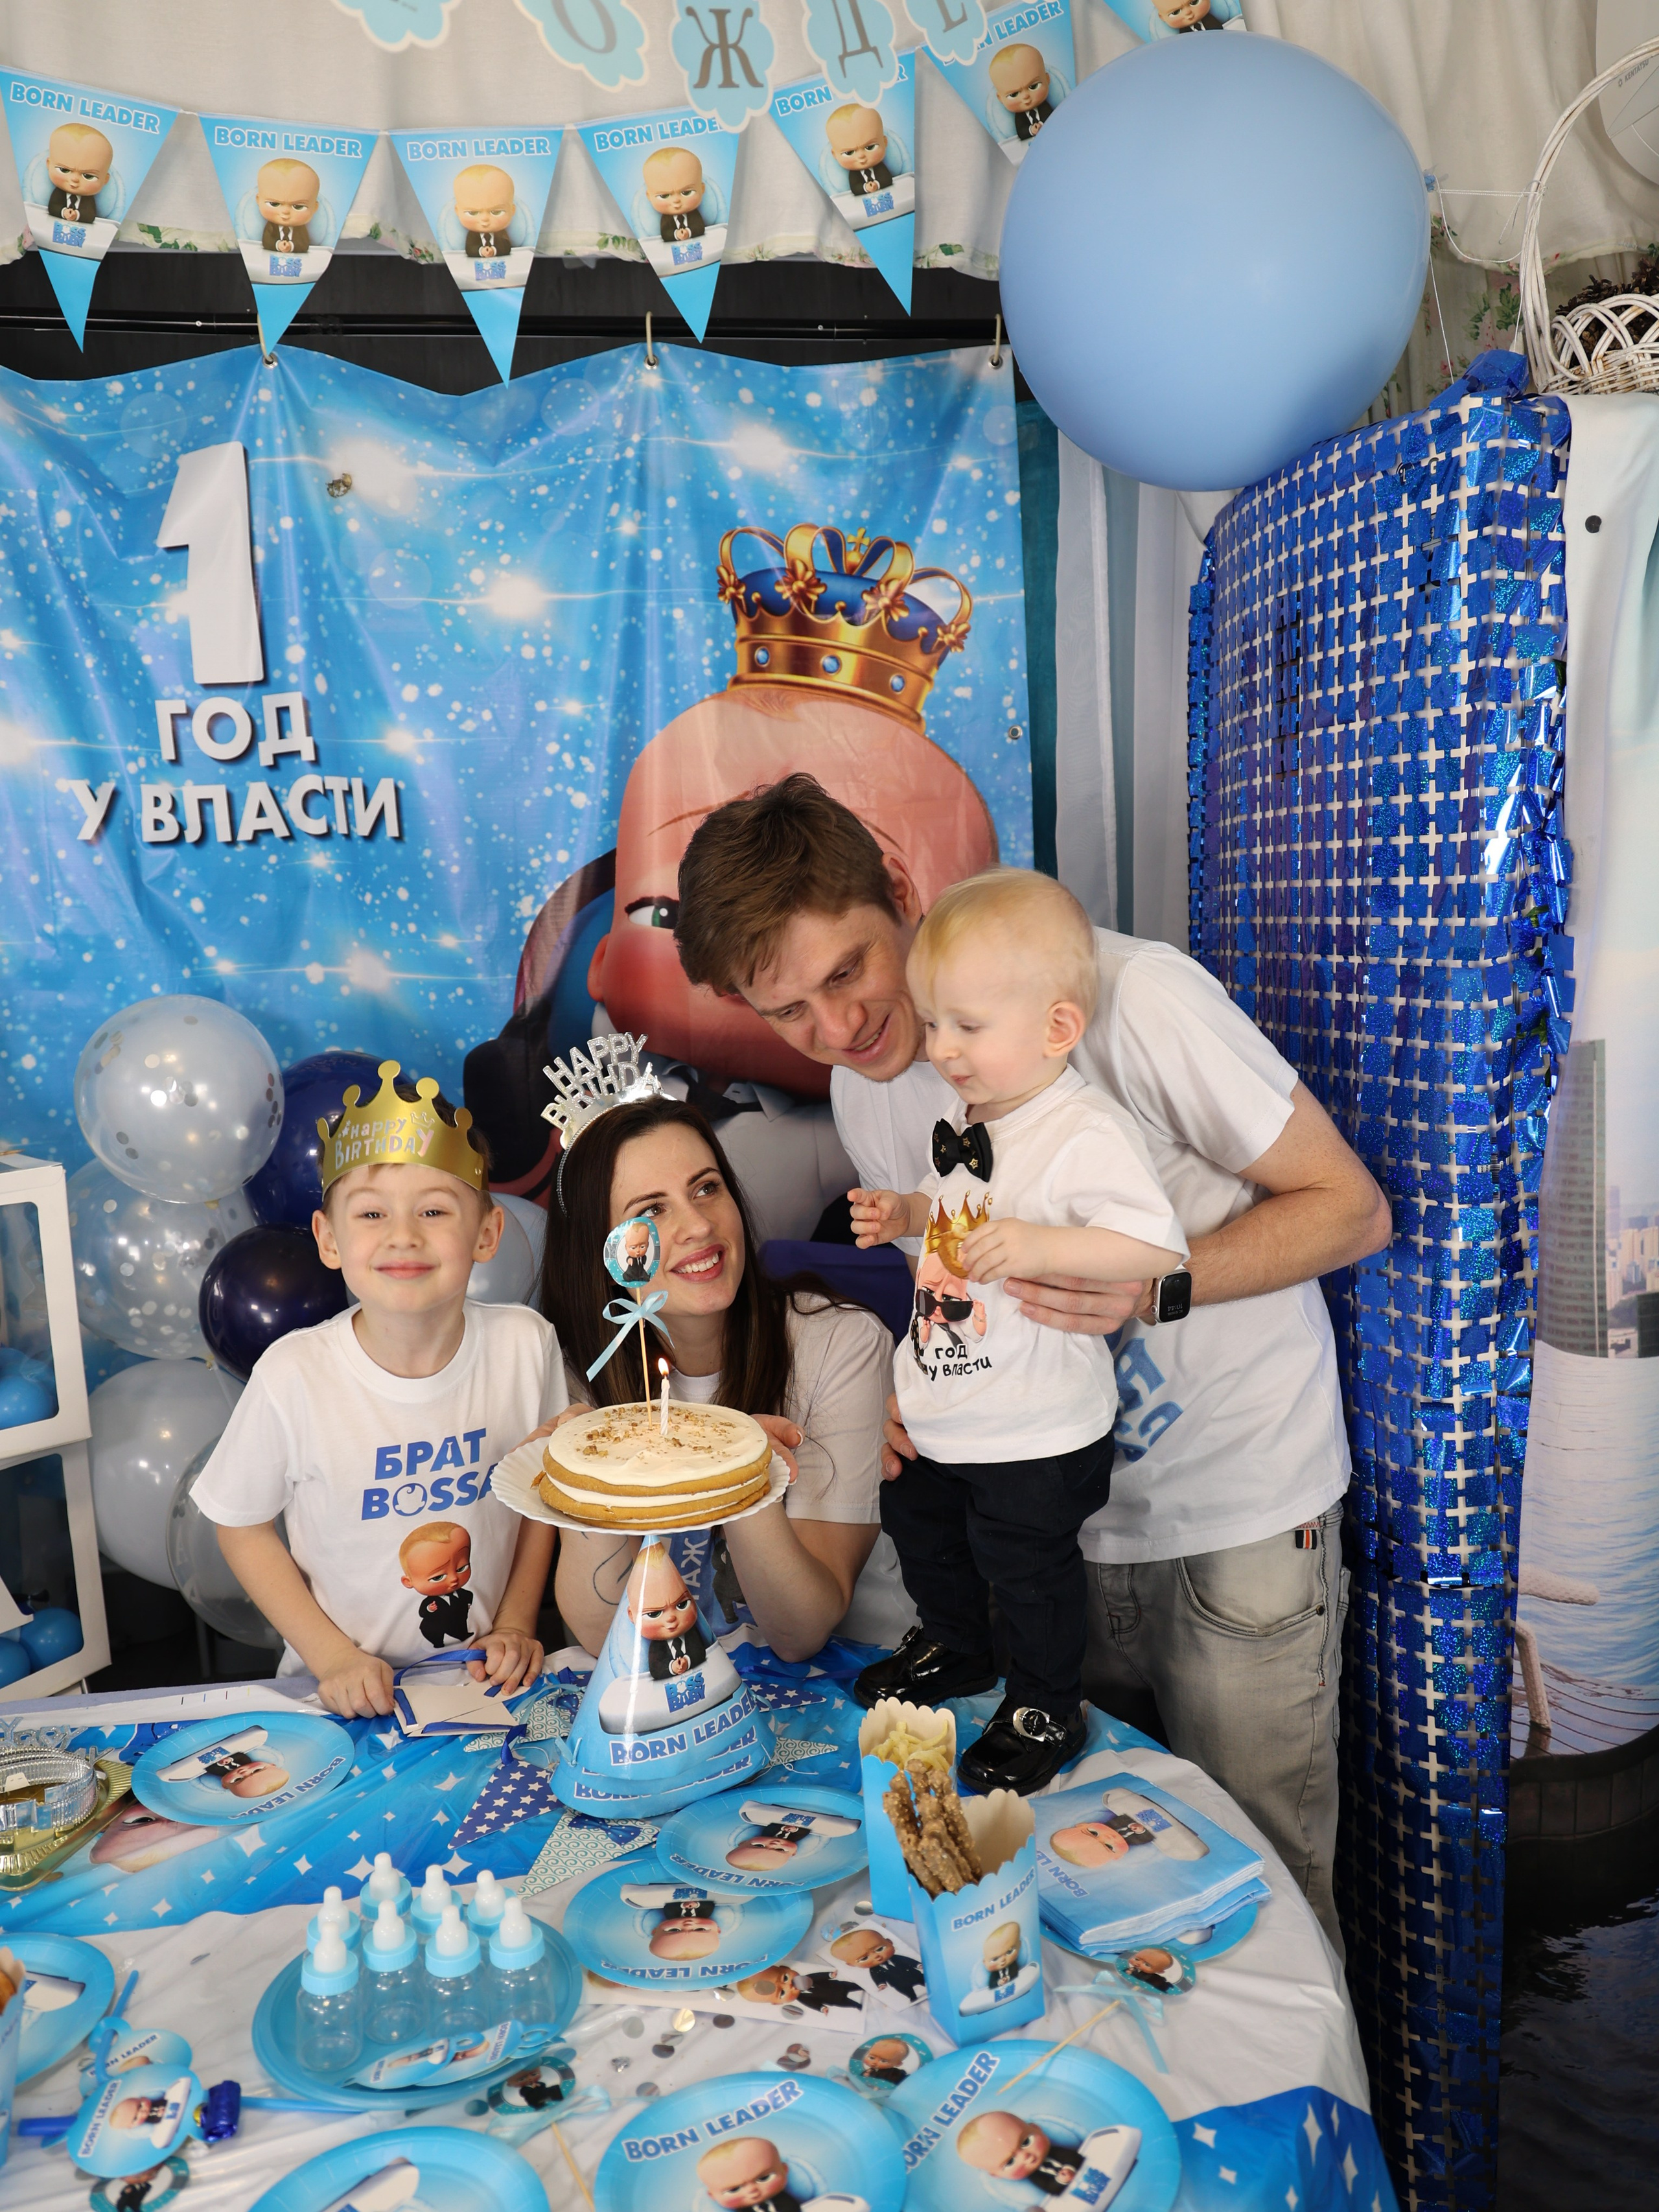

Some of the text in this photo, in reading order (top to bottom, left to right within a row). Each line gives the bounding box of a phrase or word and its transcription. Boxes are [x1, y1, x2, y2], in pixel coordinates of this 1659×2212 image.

[993, 1, 1064, 41] LEADER
[1625, 59, 1649, 82] KENTATSU
[10, 82, 160, 134] BORN LEADER
[775, 85, 833, 116] BORN
[215, 126, 362, 158] BORN LEADER
[407, 137, 551, 161] BORN LEADER
[594, 124, 653, 152] BORN
[157, 441, 264, 684] 1
[155, 692, 316, 767] ГОД
[67, 774, 401, 843] У ВЛАСТИ
[542, 1032, 648, 1095] HAPPY
[335, 1128, 434, 1170] BIRTHDAY
[375, 1428, 486, 1480] БРАТ
[664, 1671, 704, 1698] BOSS
[667, 1684, 705, 1713] BABY
[609, 1732, 688, 1766] BORN
[294, 1756, 346, 1793] BORN
[669, 1853, 747, 1885] LEADER
[1047, 1865, 1090, 1898] BORN
[953, 1866, 1036, 1931] BORN LEADER
[121, 2034, 159, 2060] LEADER
[929, 2051, 1001, 2128] LEADER
[80, 2080, 119, 2156] BORN LEADER
[621, 2078, 804, 2162] BORN LEADER
